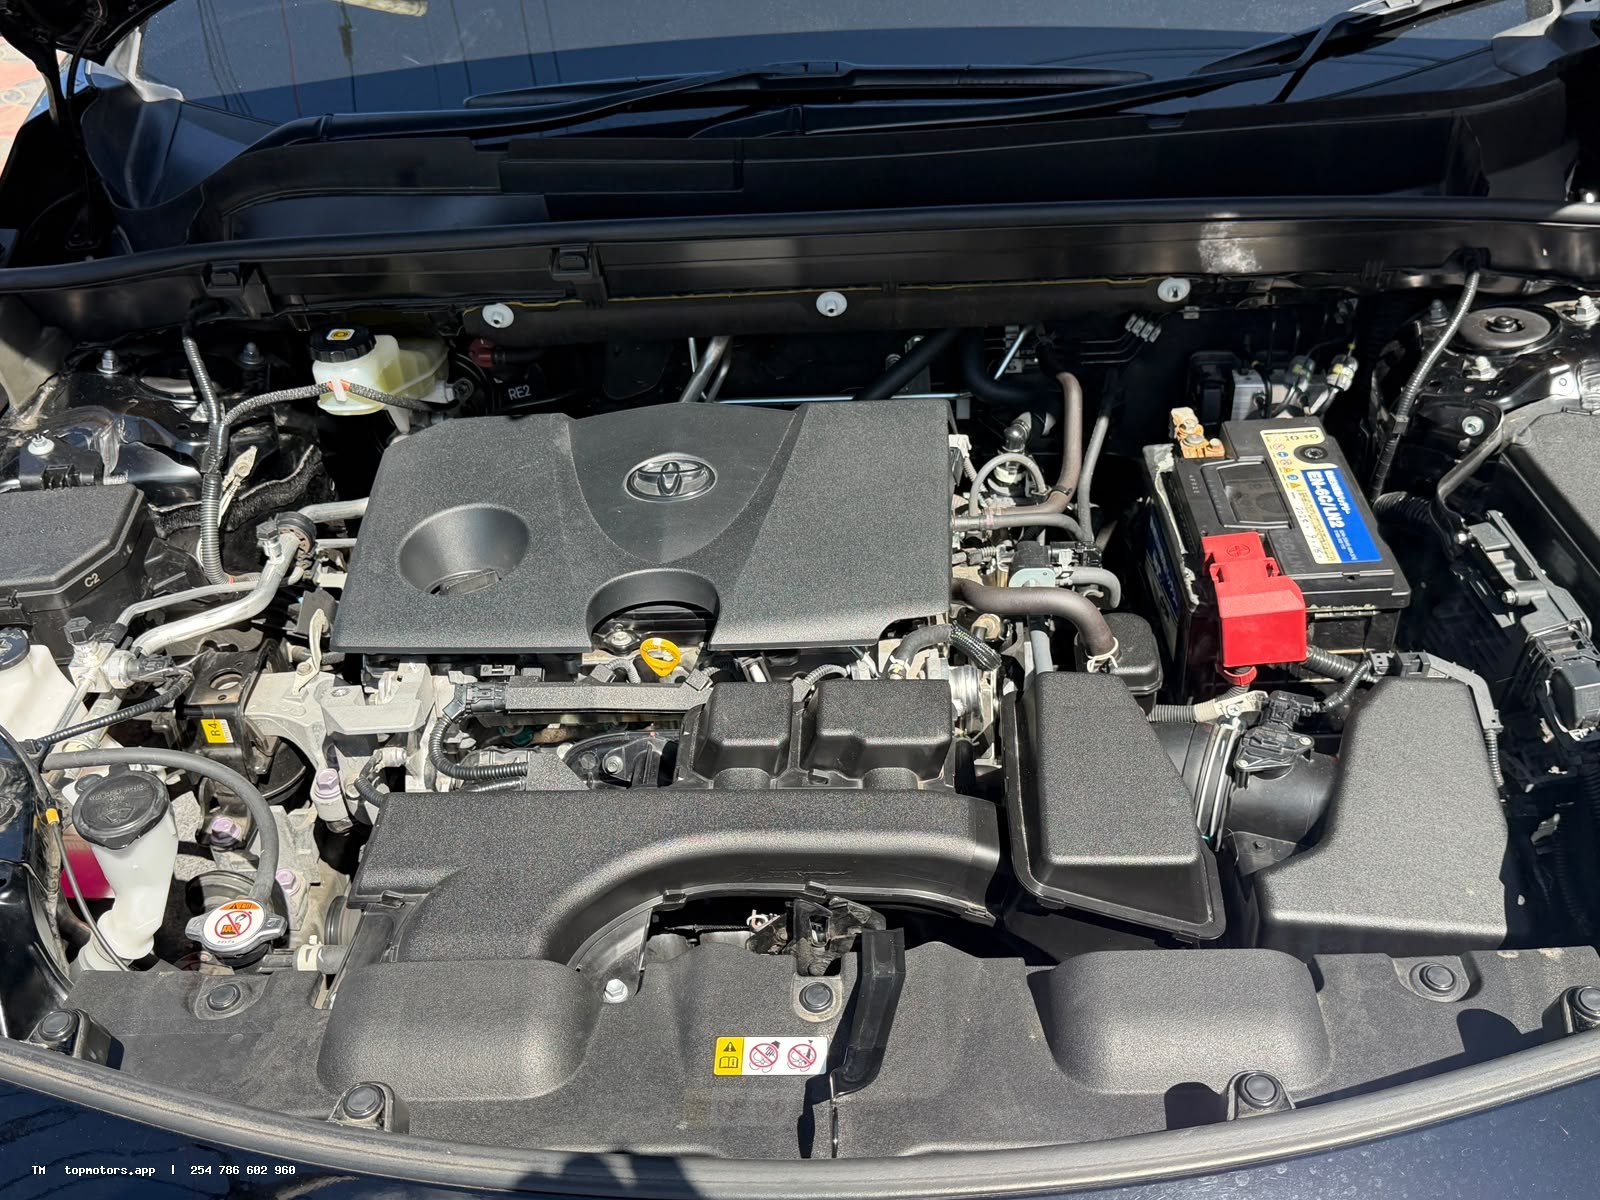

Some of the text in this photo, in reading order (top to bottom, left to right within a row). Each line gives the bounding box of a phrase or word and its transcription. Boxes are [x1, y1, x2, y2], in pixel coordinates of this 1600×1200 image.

[508, 384, 531, 401] RE2
[1307, 471, 1345, 528] EN-6C/LN2
[84, 572, 101, 589] C2
[208, 723, 221, 737] R4
